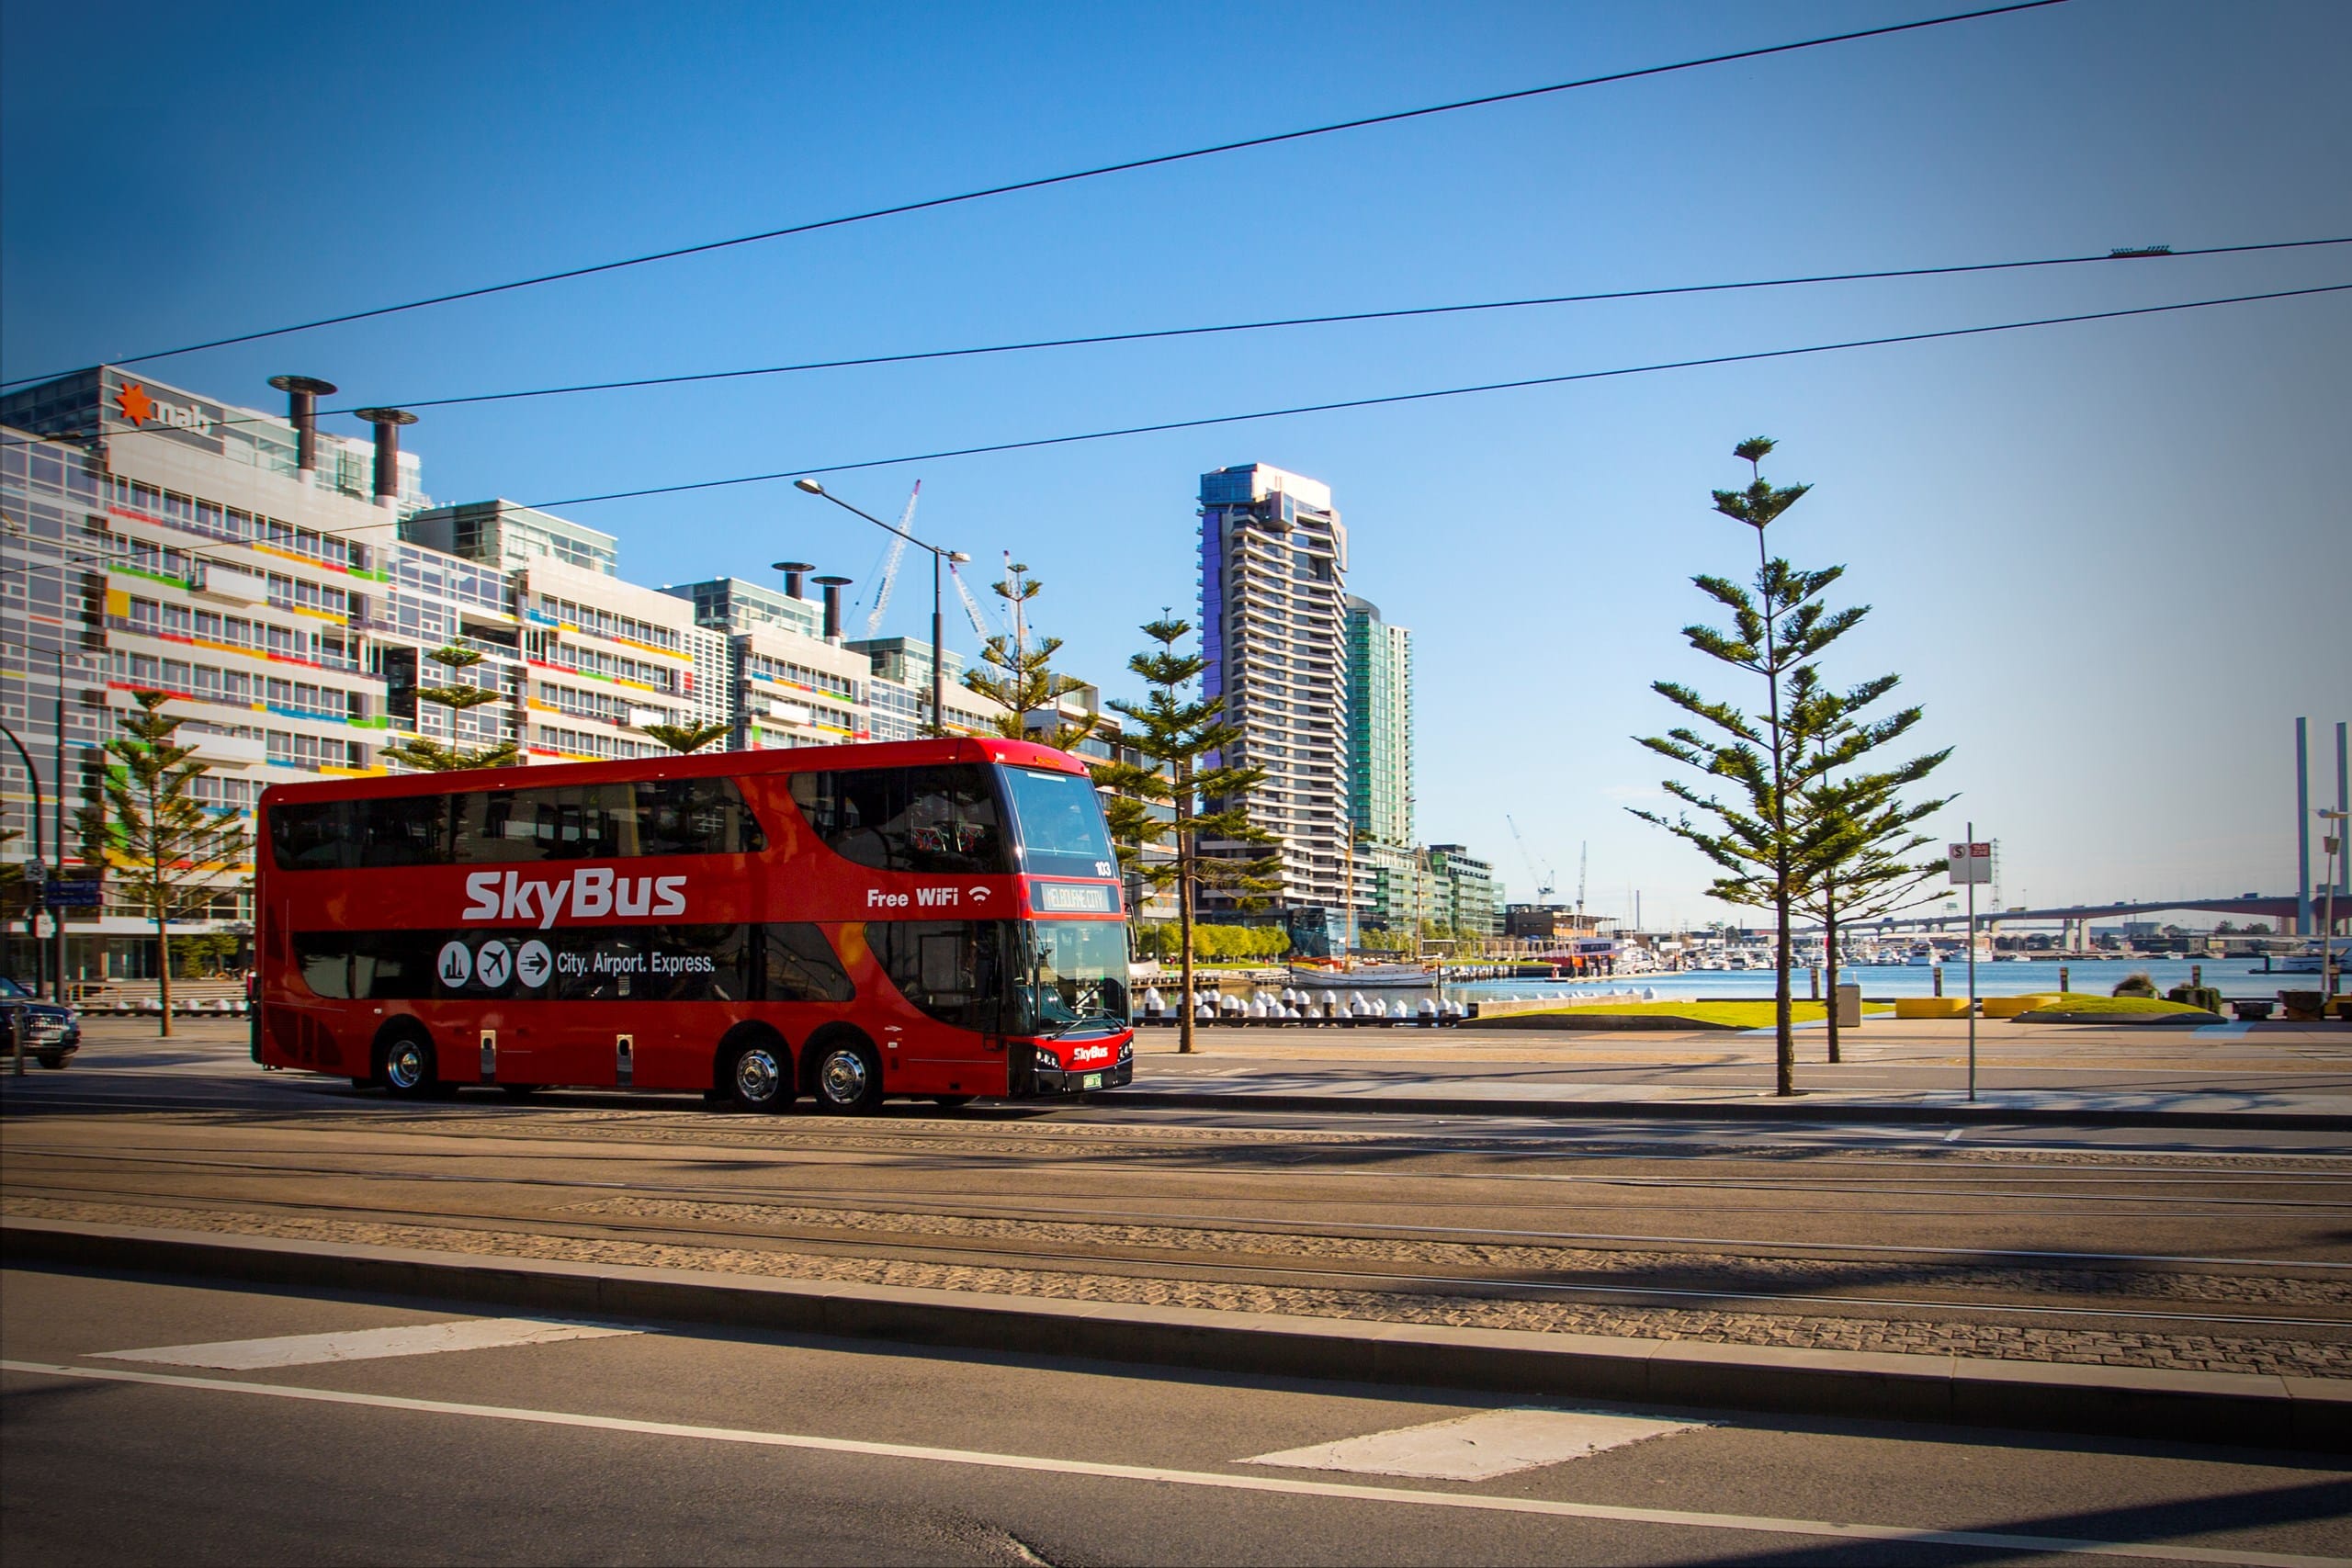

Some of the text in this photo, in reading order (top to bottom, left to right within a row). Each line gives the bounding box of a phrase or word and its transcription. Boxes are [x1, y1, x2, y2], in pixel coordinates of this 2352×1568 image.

[152, 400, 211, 435] nab
[1095, 861, 1112, 876] 103
[462, 867, 687, 930] SkyBus
[867, 887, 958, 907] Free WiFi
[1086, 890, 1102, 908] CITY
[557, 951, 716, 977] City. Airport. Express.
[1073, 1045, 1108, 1061] SkyBus
